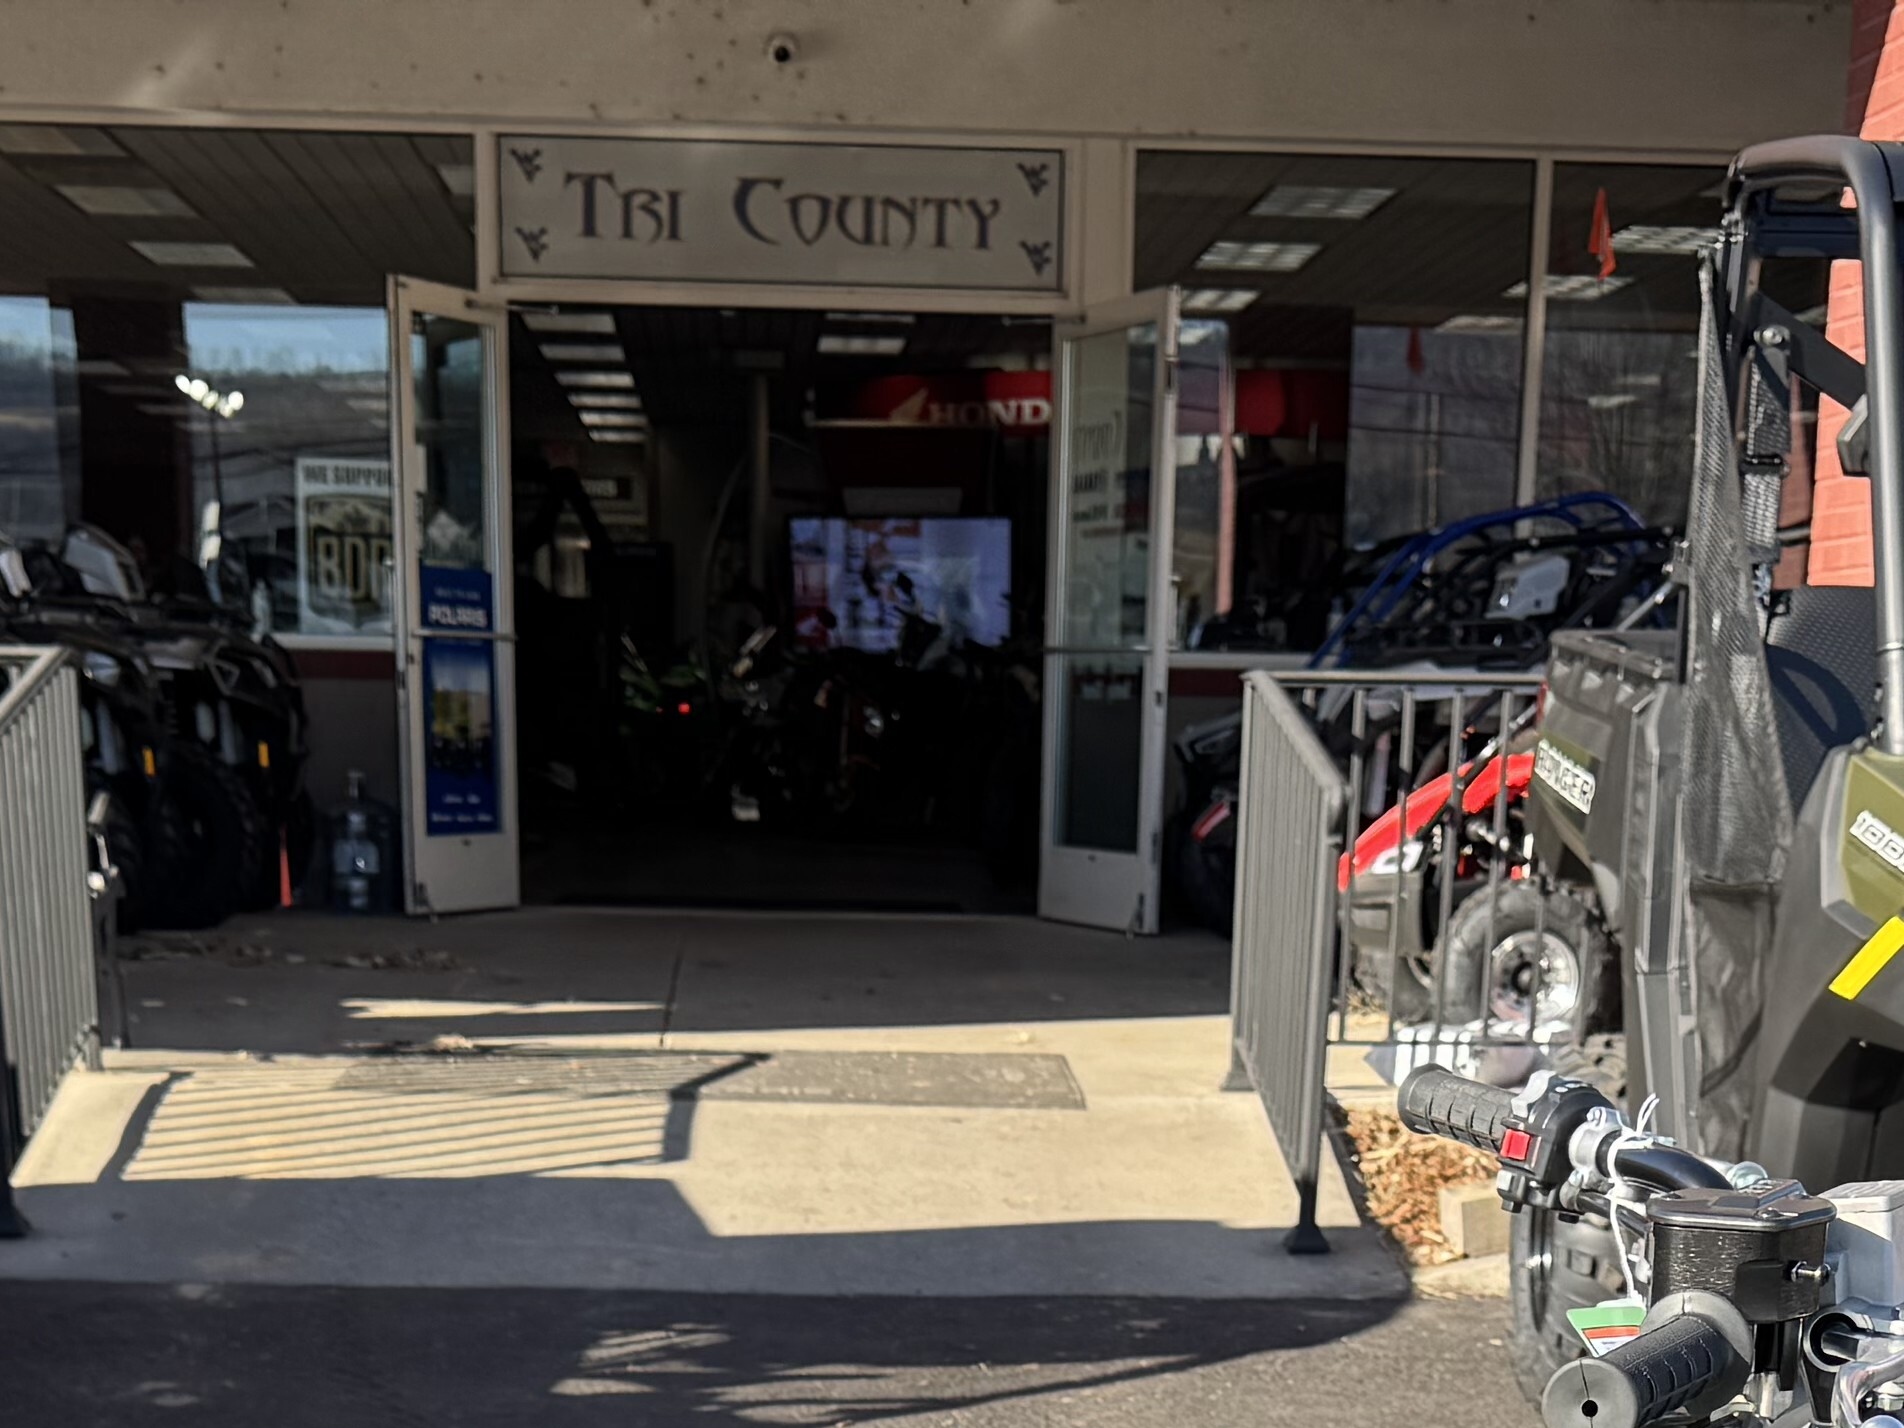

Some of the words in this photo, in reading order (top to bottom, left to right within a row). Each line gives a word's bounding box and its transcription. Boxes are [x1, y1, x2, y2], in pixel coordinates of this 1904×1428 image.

[734, 175, 1002, 253] COUNTY
[927, 398, 1052, 427] HOND
[1536, 738, 1596, 815] RANGER
